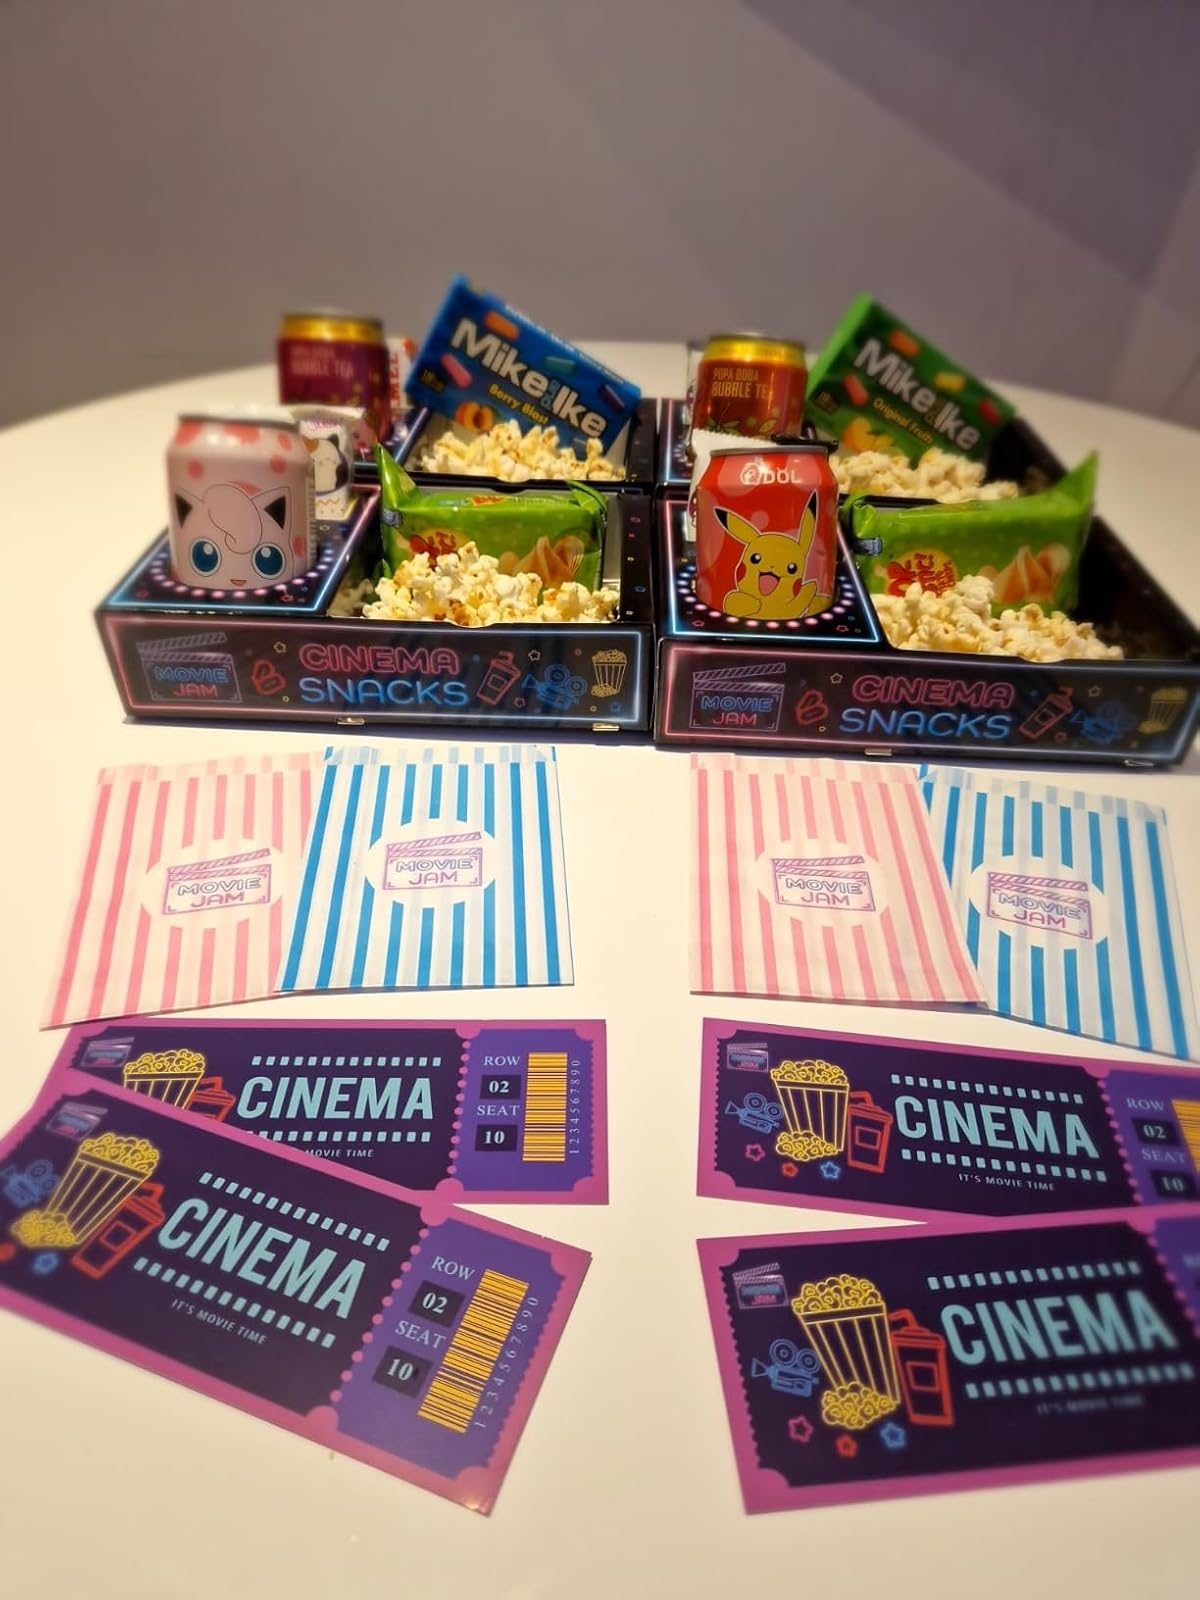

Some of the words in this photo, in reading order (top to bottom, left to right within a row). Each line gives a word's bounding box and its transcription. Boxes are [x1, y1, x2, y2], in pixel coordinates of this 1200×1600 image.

[451, 317, 549, 399] Mike
[551, 386, 607, 437] Ike
[711, 381, 753, 399] BUBBLE
[853, 338, 936, 413] Mike
[934, 401, 981, 449] Ike
[488, 383, 521, 411] Berry
[521, 401, 549, 425] Blast
[873, 397, 911, 430] Original
[299, 643, 460, 675] CINEMA
[153, 666, 229, 684] MOVIE
[173, 683, 218, 697] JAM
[299, 677, 468, 706] SNACKS
[852, 675, 1016, 709] CINEMA
[701, 695, 774, 713] MOVIE
[713, 712, 758, 726] JAM
[840, 708, 1013, 739] SNACKS
[396, 858, 473, 873] MOVIE
[177, 878, 261, 896] MOVIE
[409, 871, 458, 885] JAM
[785, 878, 863, 895] MOVIE
[190, 892, 245, 908] JAM
[801, 892, 850, 906] JAM
[998, 892, 1082, 920] MOVIE
[1014, 910, 1066, 929] JAM
[483, 1056, 520, 1066] ROW
[488, 1080, 510, 1093] 02
[236, 1076, 434, 1119] CINEMA
[1126, 1097, 1164, 1111] ROW
[477, 1105, 520, 1116] SEAT
[894, 1095, 1100, 1159] CINEMA
[1143, 1124, 1167, 1139] 02
[483, 1131, 505, 1144] 10
[346, 1149, 375, 1158] TIME
[1141, 1148, 1185, 1164] SEAT
[958, 1173, 982, 1184] IT'S
[985, 1176, 1024, 1188] MOVIE
[1026, 1180, 1055, 1191] TIME
[1161, 1176, 1185, 1192] 10
[158, 1198, 366, 1319] CINEMA
[431, 1255, 476, 1281] ROW
[422, 1292, 448, 1314] 02
[171, 1299, 196, 1316] IT'S
[196, 1309, 236, 1332] MOVIE
[237, 1325, 268, 1345] TIME
[940, 1289, 1180, 1365] CINEMA
[394, 1320, 447, 1349] SEAT
[387, 1358, 414, 1381] 10
